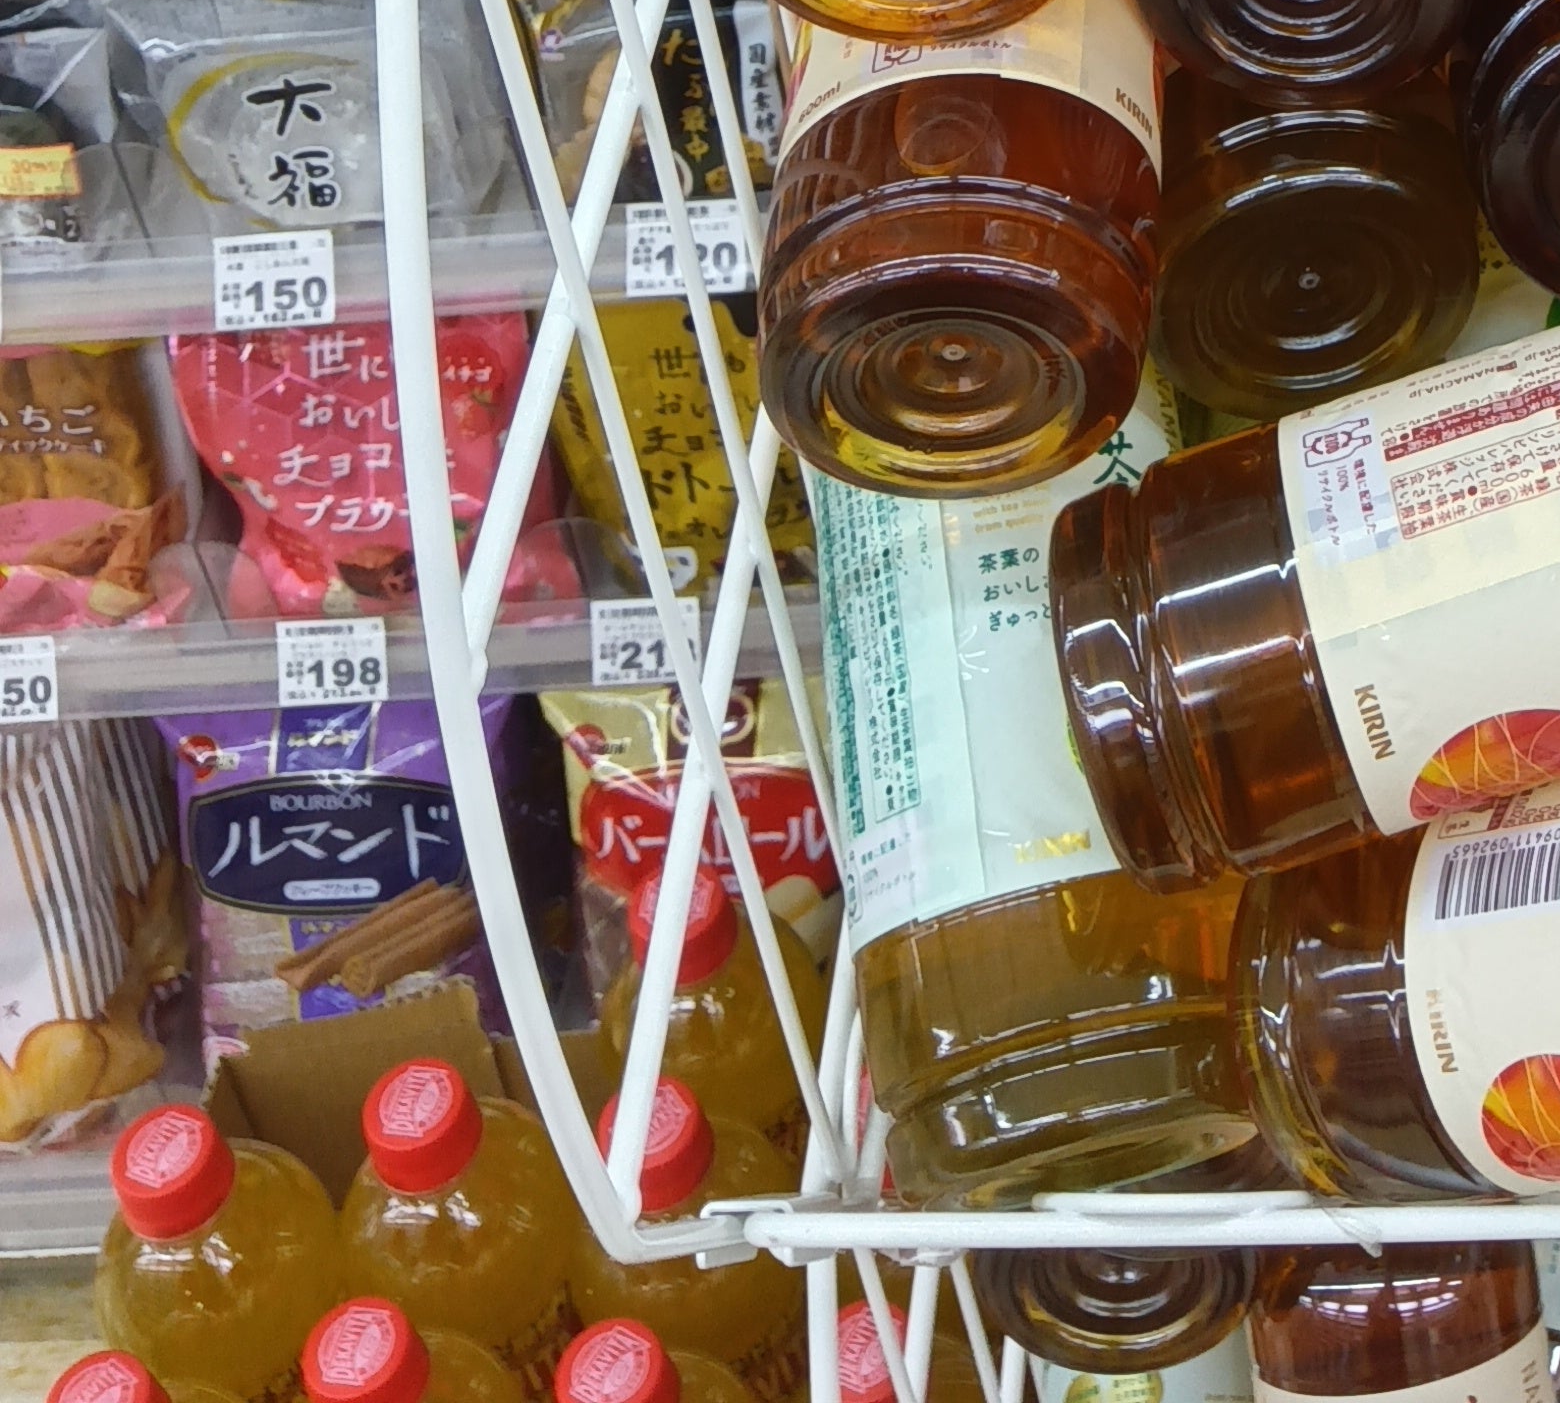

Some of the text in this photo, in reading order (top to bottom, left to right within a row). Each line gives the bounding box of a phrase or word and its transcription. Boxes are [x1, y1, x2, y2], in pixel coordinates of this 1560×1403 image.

[798, 81, 841, 124] 600ml
[1115, 88, 1153, 139] KIRIN
[245, 76, 340, 208] 大福
[245, 276, 327, 312] 150
[1336, 464, 1350, 491] 100%
[1318, 469, 1340, 546] リサイクルボトル
[978, 547, 1040, 574] 茶葉の
[308, 662, 380, 691] 198
[1353, 684, 1396, 762] KIRIN
[269, 793, 373, 812] BOURBON
[208, 804, 450, 879] ルマンド
